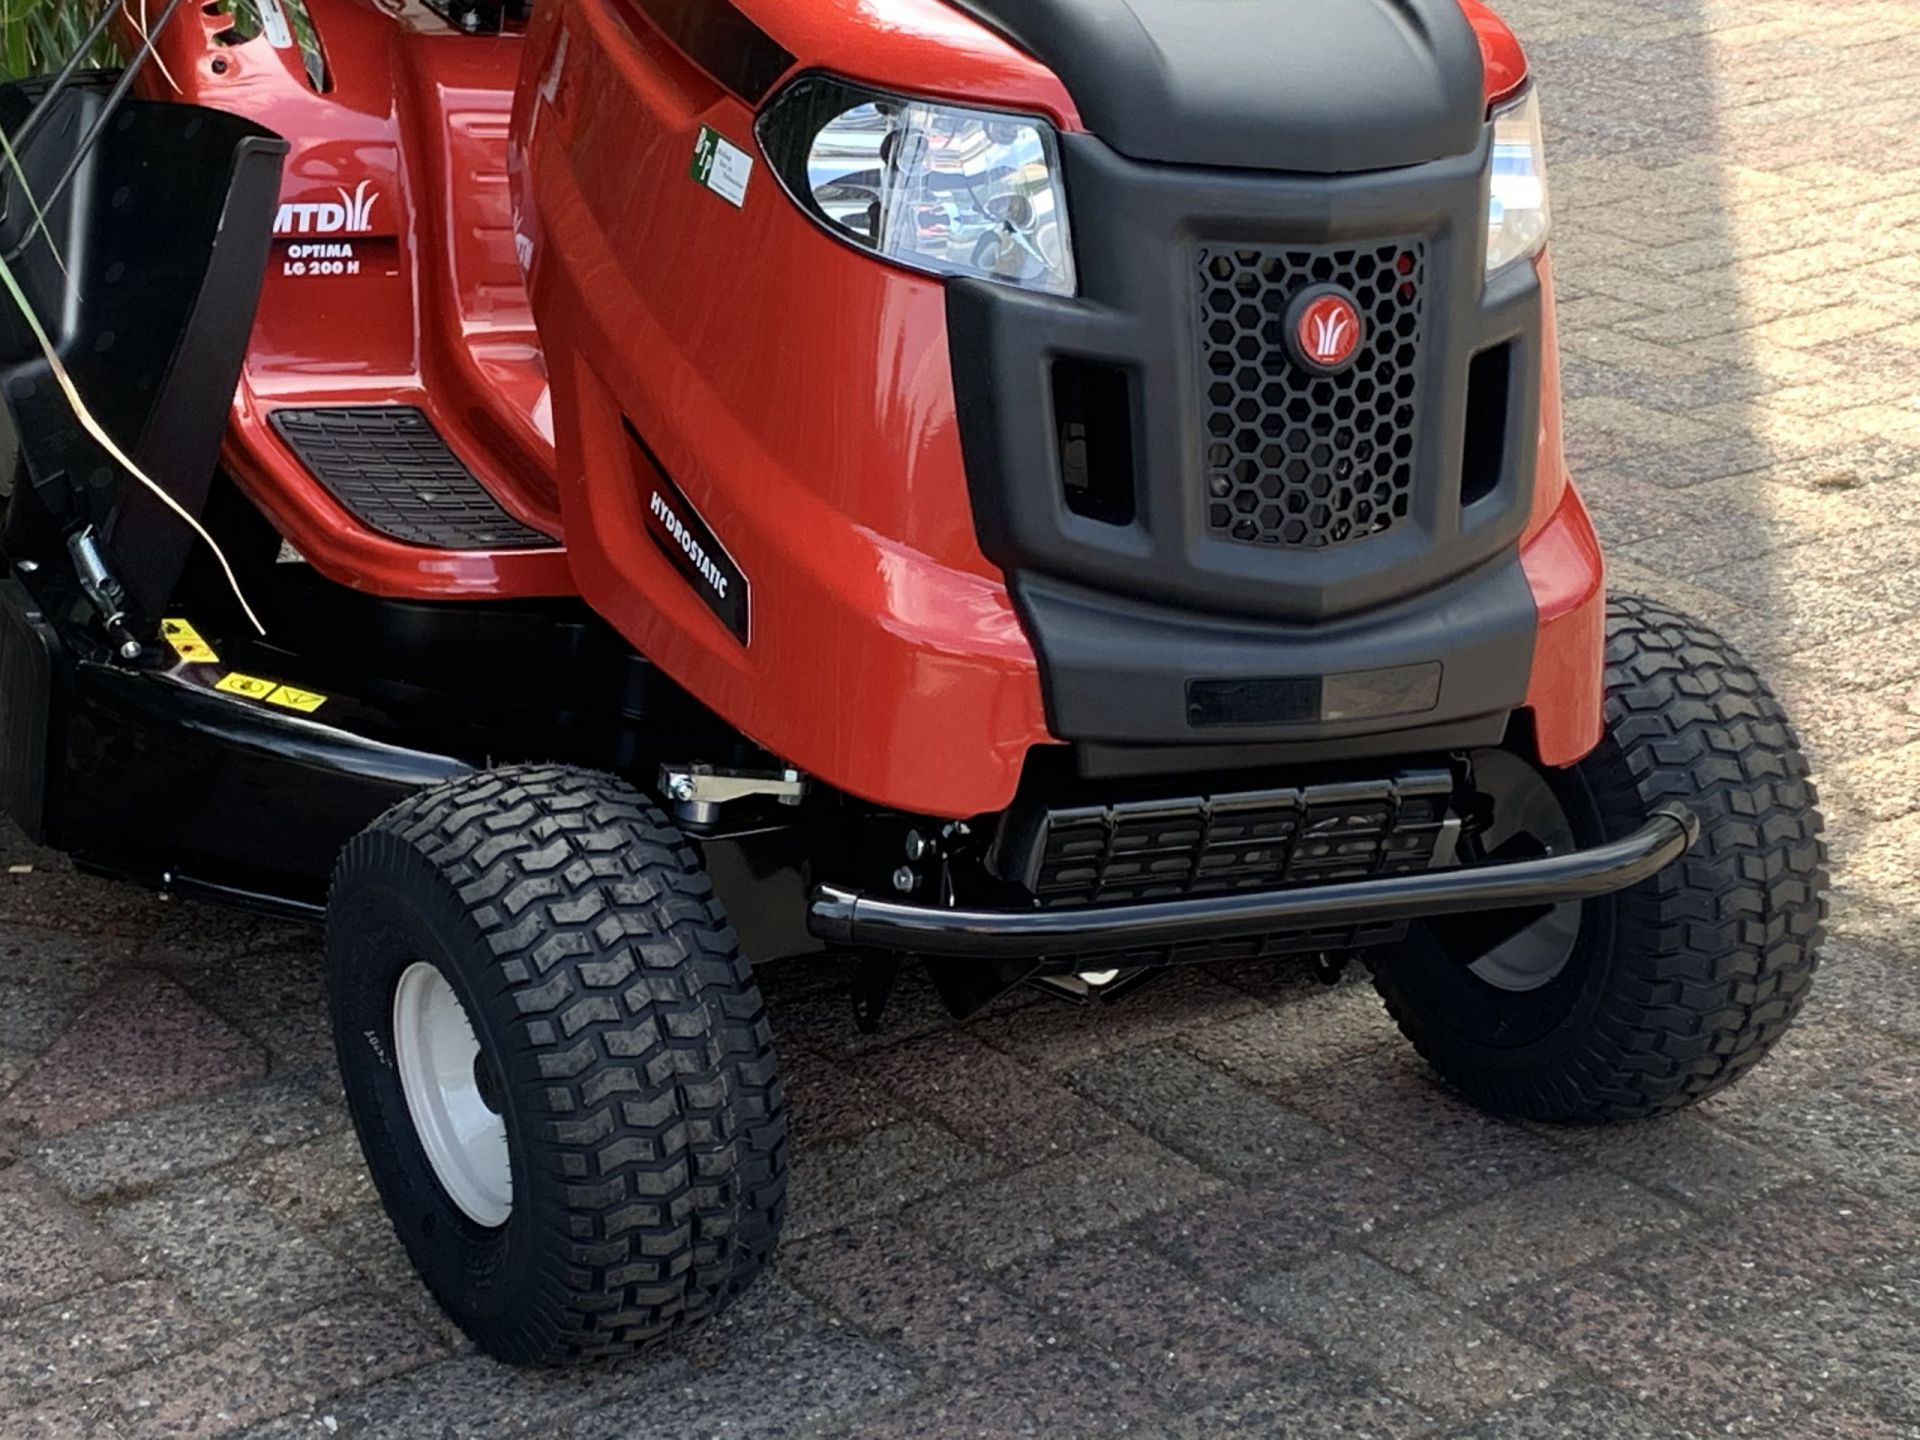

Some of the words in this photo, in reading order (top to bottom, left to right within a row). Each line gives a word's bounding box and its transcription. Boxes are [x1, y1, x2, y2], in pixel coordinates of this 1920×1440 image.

[288, 244, 352, 258] OPTIMA
[283, 262, 306, 276] LG
[308, 261, 344, 275] 200
[347, 261, 360, 274] H
[650, 491, 728, 599] HYDROSTATIC
